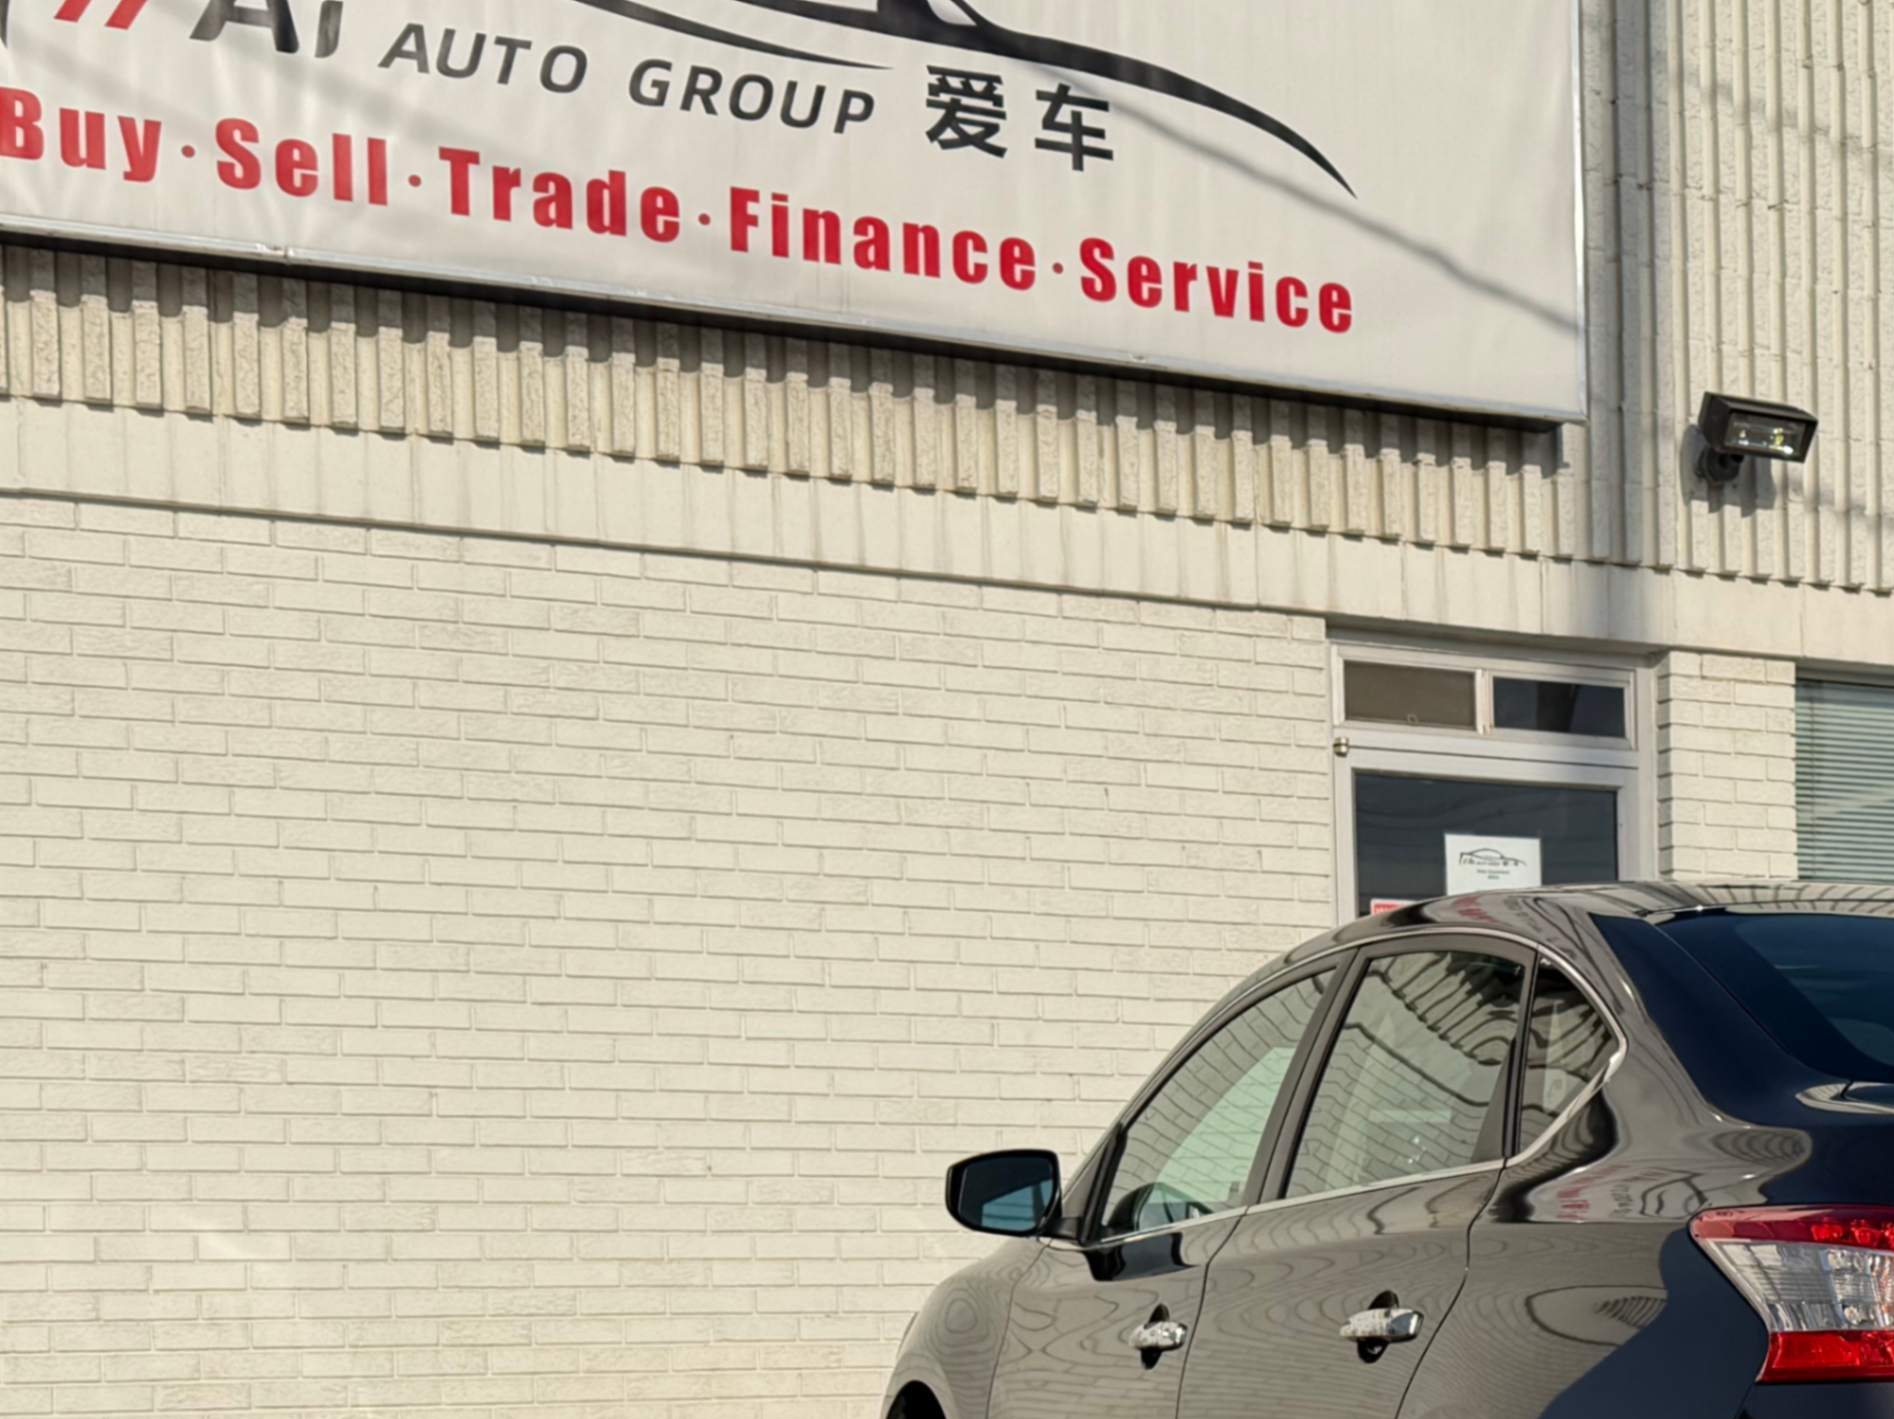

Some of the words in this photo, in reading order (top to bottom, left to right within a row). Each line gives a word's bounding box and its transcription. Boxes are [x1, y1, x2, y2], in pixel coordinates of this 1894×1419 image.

[378, 23, 588, 94] AUTO
[629, 59, 875, 134] GROUP
[926, 65, 1114, 172] 爱车
[0, 86, 162, 183] Buy
[215, 117, 389, 205] Sell
[438, 147, 681, 244] Trade
[730, 186, 1036, 291] Finance
[1080, 238, 1354, 334] Service
